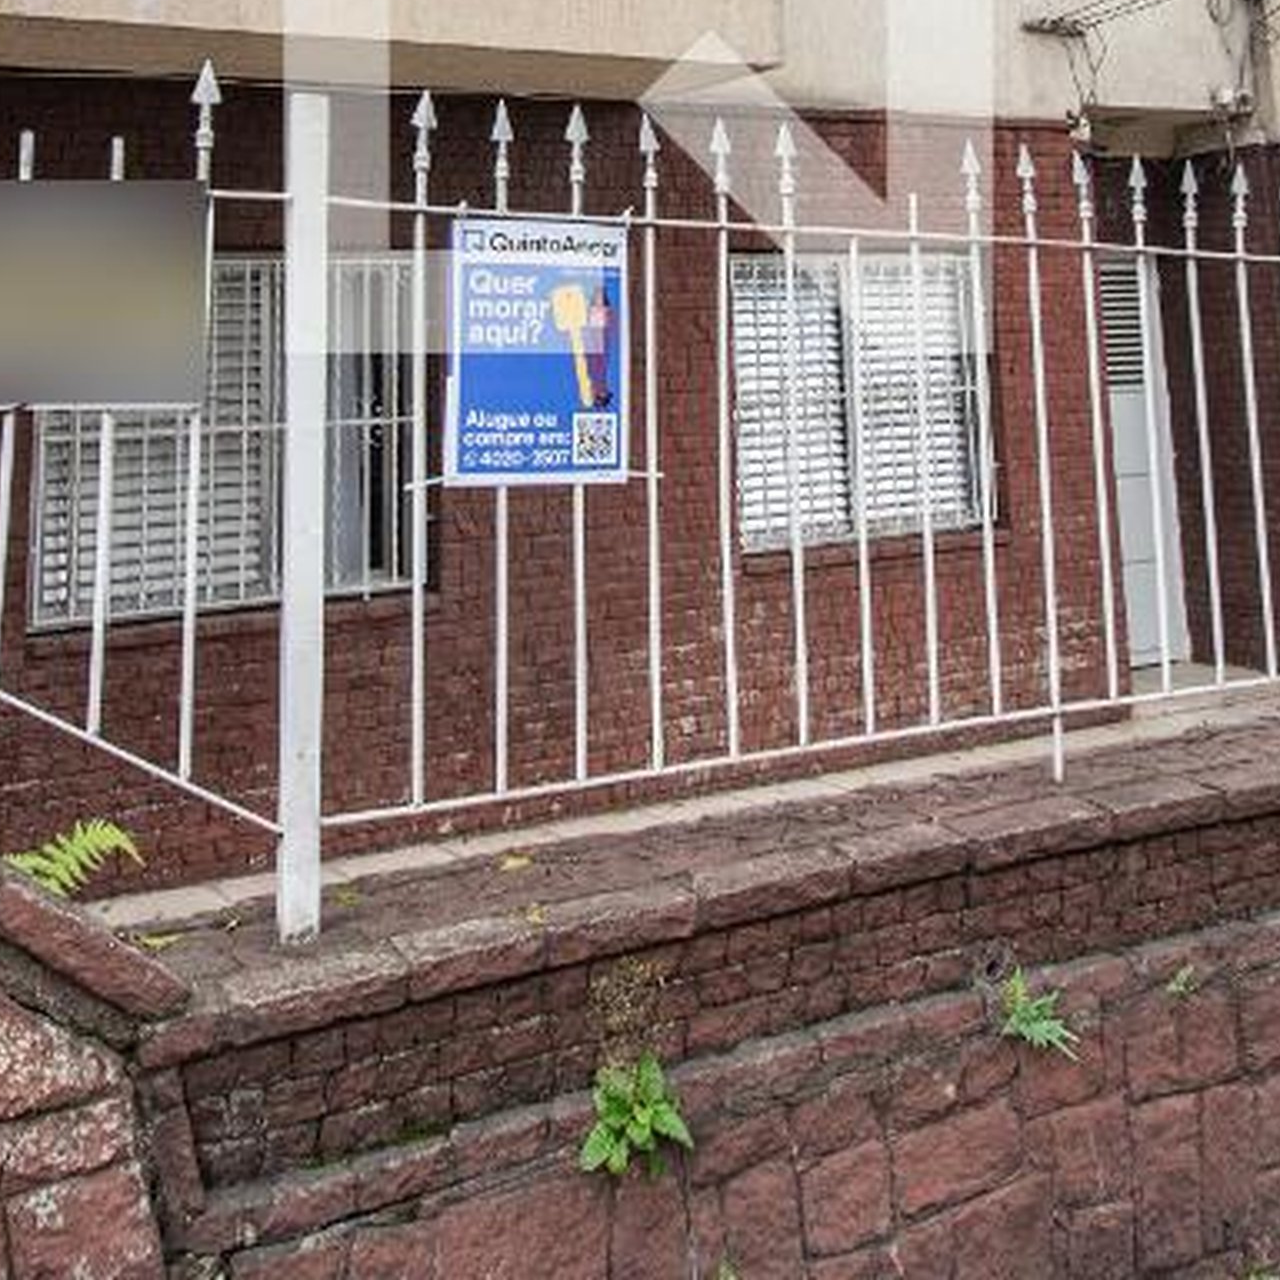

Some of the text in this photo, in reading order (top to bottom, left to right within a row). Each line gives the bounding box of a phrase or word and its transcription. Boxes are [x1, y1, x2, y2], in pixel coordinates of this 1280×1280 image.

[469, 268, 538, 295] Quer
[469, 298, 550, 319] morar
[468, 319, 544, 347] aqui?
[533, 413, 558, 428] ou
